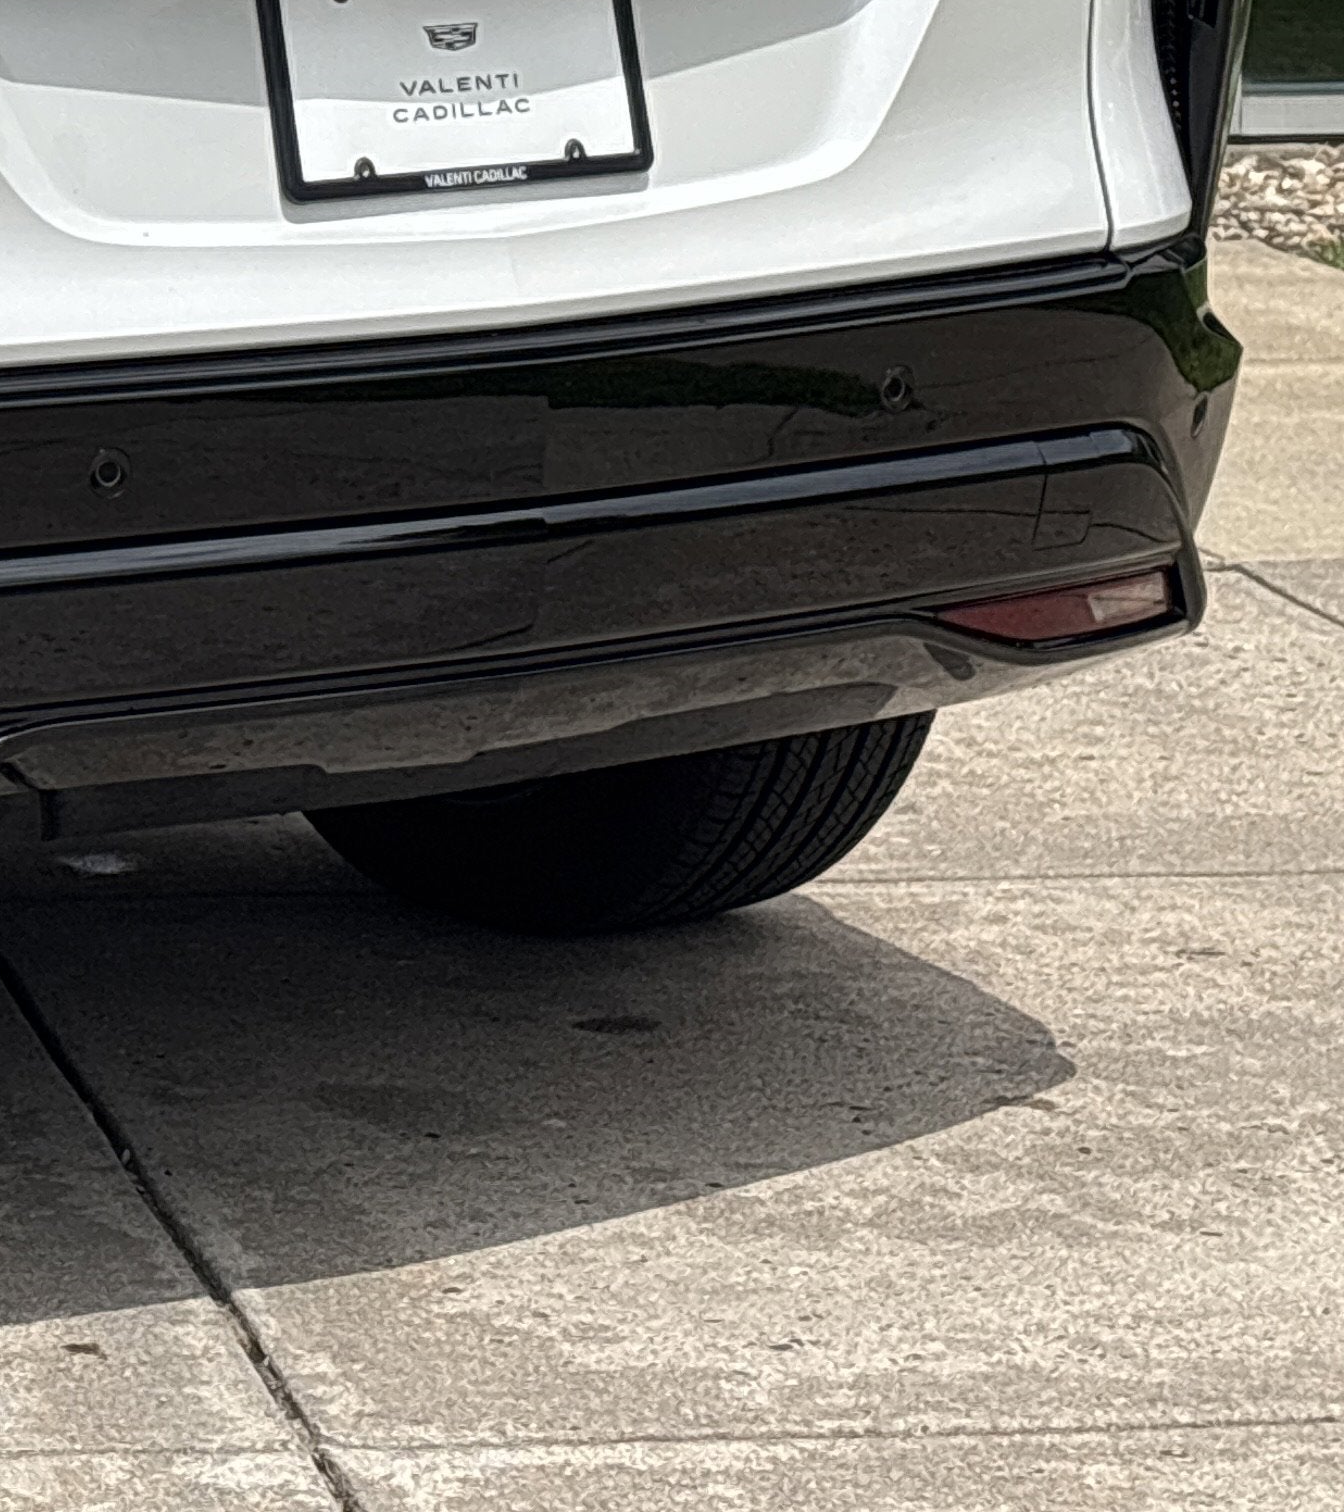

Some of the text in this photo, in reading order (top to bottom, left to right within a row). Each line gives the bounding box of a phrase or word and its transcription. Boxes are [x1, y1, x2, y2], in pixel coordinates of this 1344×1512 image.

[399, 73, 518, 96] VALENTI
[392, 98, 531, 123] CADILLAC
[424, 166, 528, 188] VALENTI CADILLAC
